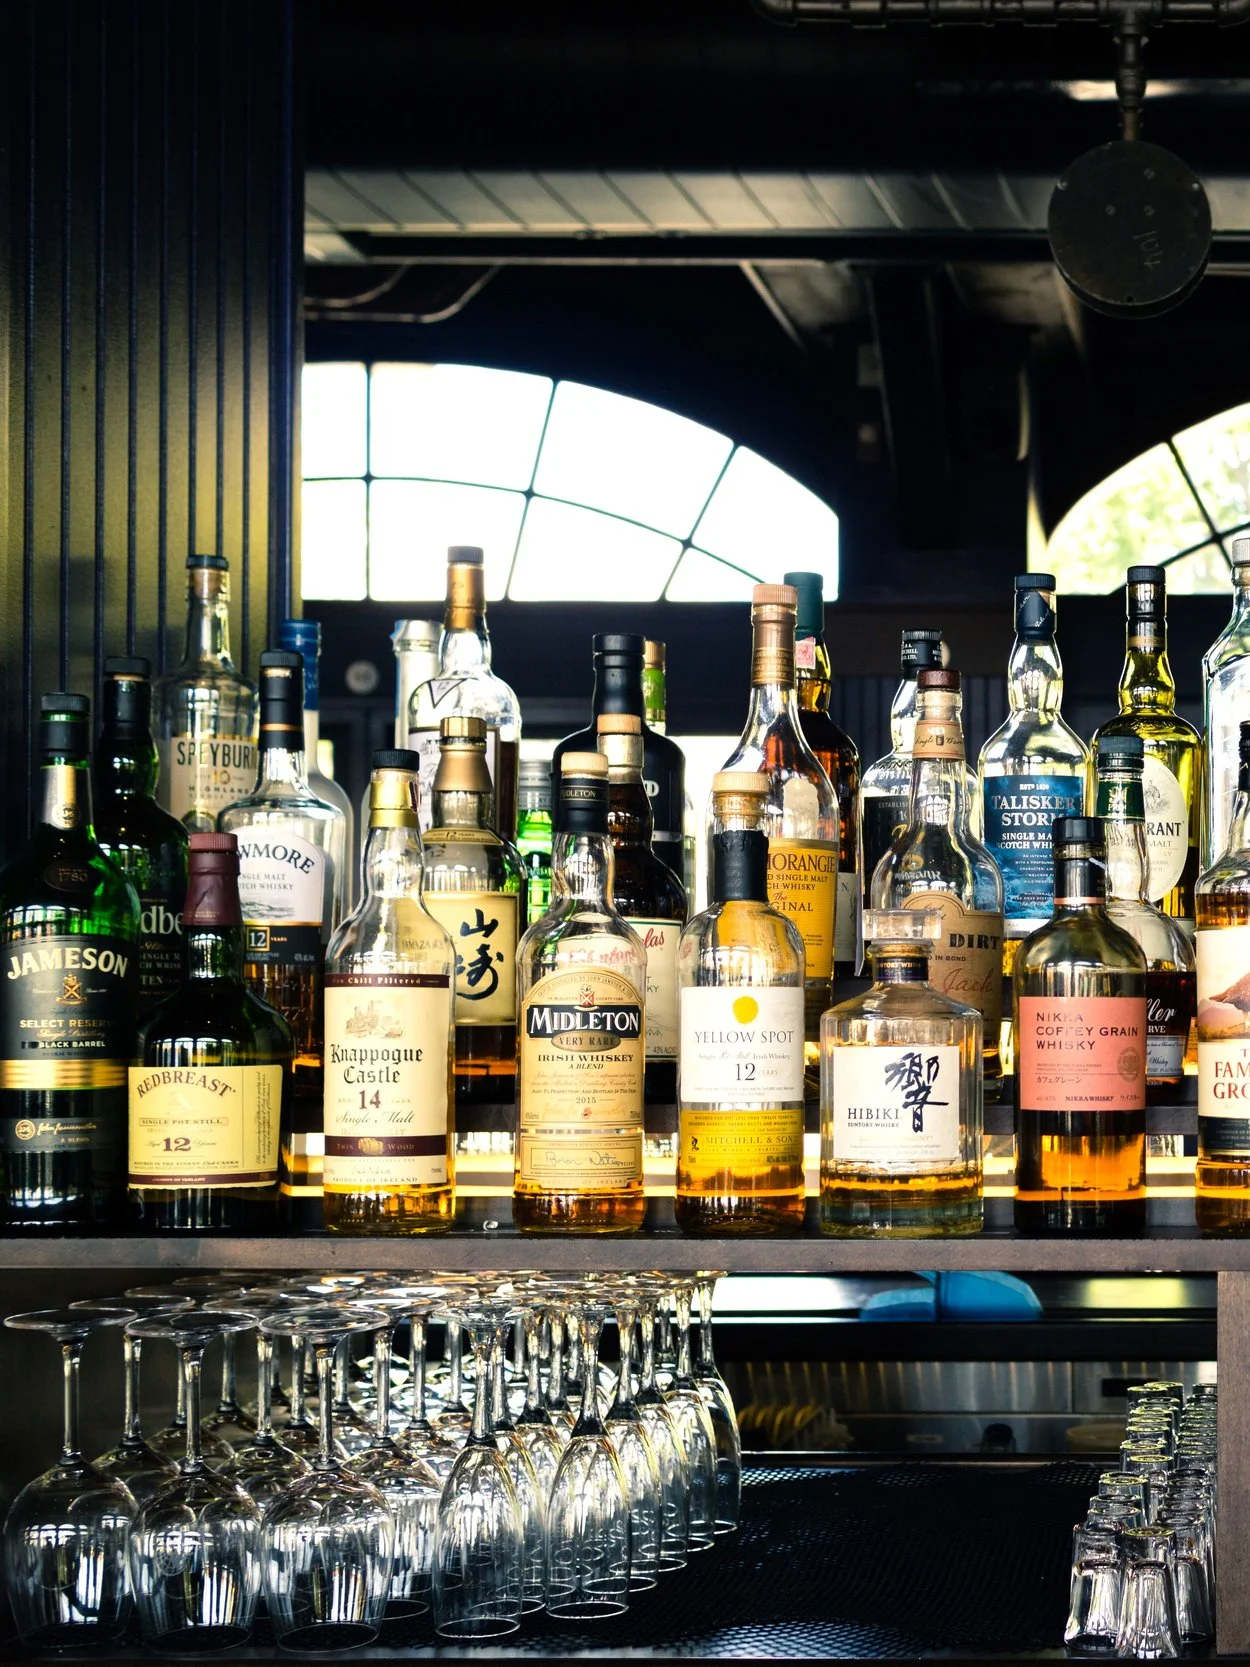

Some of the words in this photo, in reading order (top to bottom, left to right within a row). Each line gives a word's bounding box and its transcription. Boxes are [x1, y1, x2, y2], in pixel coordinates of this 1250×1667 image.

[991, 795, 1076, 810] TALISKER
[1146, 821, 1182, 836] RANT
[998, 841, 1031, 849] SCOTCH
[238, 843, 316, 875] WMORE
[768, 853, 835, 873] ORANGIE
[264, 873, 286, 881] MALT
[811, 875, 828, 883] MALT
[259, 883, 294, 891] WHISKY
[783, 883, 816, 891] WHISKY
[775, 901, 814, 912] GINAL
[141, 905, 184, 935] dbe
[249, 930, 266, 947] 12
[7, 947, 128, 980] JAMESON
[348, 976, 372, 984] Chill
[377, 976, 421, 984] Filtered
[20, 1019, 63, 1028] SELECT
[530, 1007, 639, 1034] MIDLETON
[1036, 1012, 1084, 1022] NIKKA
[695, 1031, 756, 1044] YELLOW
[761, 1030, 794, 1043] SPOT
[1036, 1026, 1094, 1036] COFFEY
[1099, 1026, 1138, 1036] GRAIN
[559, 1037, 584, 1045] VERY
[589, 1037, 614, 1045] RARE
[1036, 1041, 1096, 1050] WHISKY
[331, 1043, 424, 1068] Knappogue
[538, 1054, 574, 1062] IRISH
[578, 1054, 634, 1062] WHISKEY
[344, 1066, 400, 1085] Castle
[735, 1062, 756, 1081] 12
[137, 1070, 232, 1099] REDBREAST
[884, 1051, 950, 1133] 響
[359, 1089, 381, 1110] 14
[336, 1111, 371, 1124] Single
[381, 1110, 415, 1124] Malt
[847, 1107, 900, 1120] HIBIKI
[163, 1137, 191, 1152] 12
[705, 1136, 763, 1145] MITCHELL
[766, 1136, 773, 1144] &
[776, 1136, 793, 1144] SON
